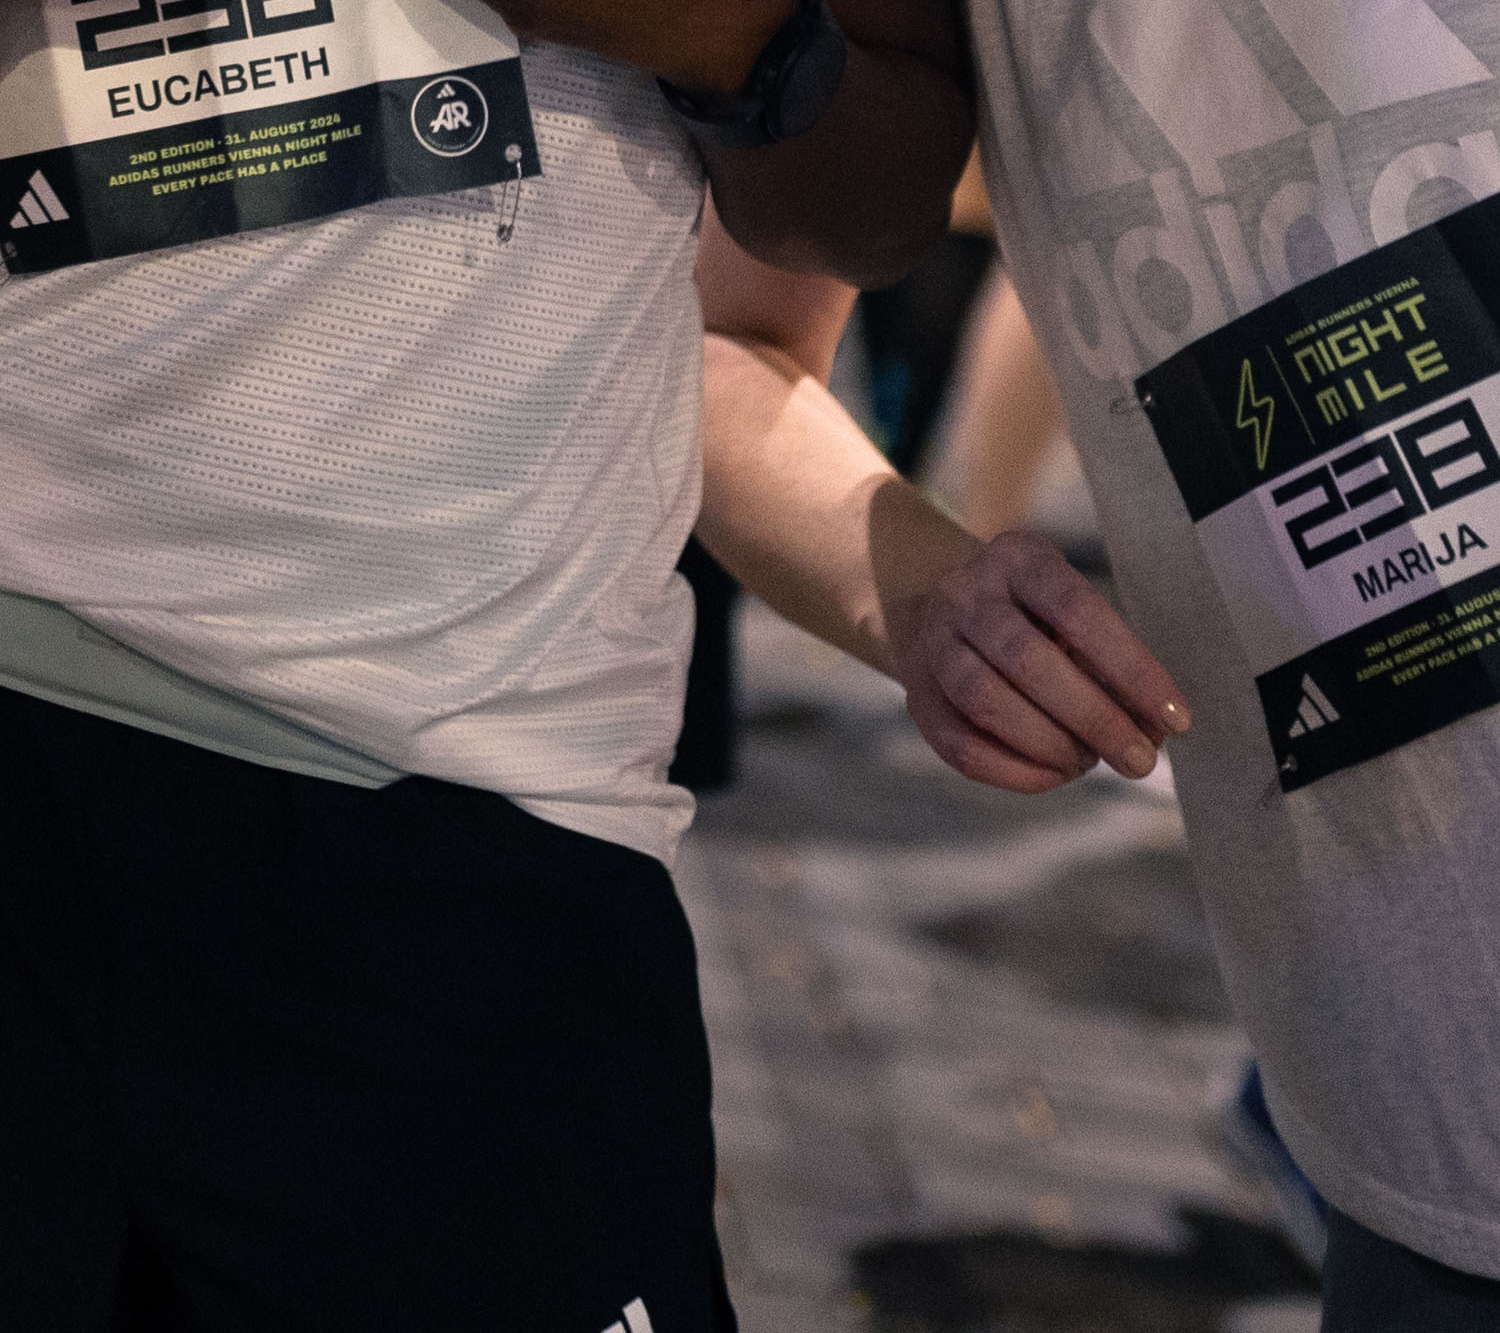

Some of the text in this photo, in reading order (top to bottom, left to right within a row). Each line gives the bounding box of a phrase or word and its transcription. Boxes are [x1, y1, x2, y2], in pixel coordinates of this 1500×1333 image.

[107, 47, 330, 118] EUCABETH
[108, 124, 362, 187] ADIDAS RUNNERS VIENNA NIGHT MILE
[129, 150, 158, 166] 2ND
[160, 138, 215, 159] EDITION
[224, 134, 246, 146] 31.
[249, 120, 306, 142] AUGUST
[309, 113, 341, 129] 2024
[151, 151, 328, 196] EVERY PACE HAS A PLACE
[1316, 296, 1374, 330] RUNNERS
[1373, 276, 1420, 303] VIENNA
[1292, 292, 1427, 384] NIGHT
[1314, 338, 1451, 426] MILE
[1352, 523, 1488, 603] MARIJA
[1484, 632, 1497, 645] A
